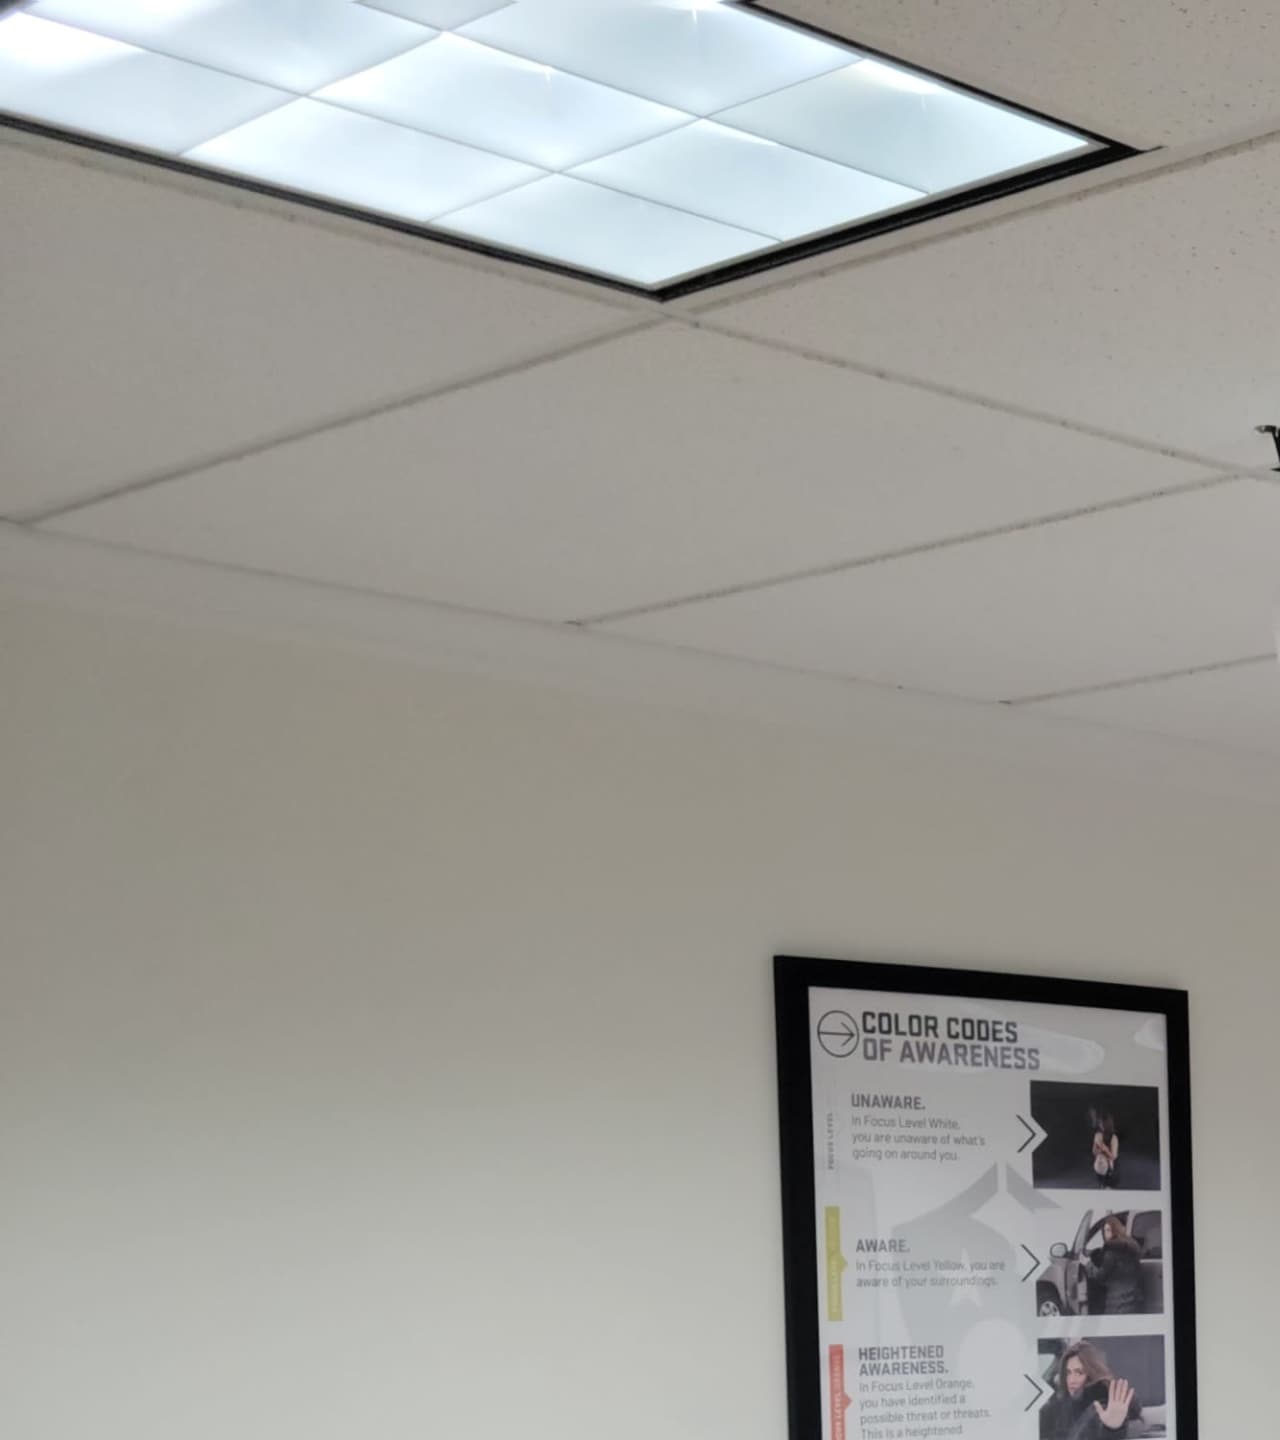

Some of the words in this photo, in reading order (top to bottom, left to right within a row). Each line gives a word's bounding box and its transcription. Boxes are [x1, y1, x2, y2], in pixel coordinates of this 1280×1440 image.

[862, 1011, 939, 1039] COLOR
[947, 1017, 1018, 1044] CODES
[863, 1038, 892, 1062] OF
[900, 1040, 1041, 1071] AWARENESS
[851, 1093, 926, 1111] UNAWARE.
[852, 1115, 861, 1126] In
[863, 1116, 896, 1128] Focus
[899, 1117, 926, 1128] Level
[852, 1131, 871, 1144] you
[874, 1132, 891, 1143] are
[893, 1132, 938, 1145] unaware
[940, 1134, 951, 1145] of
[953, 1134, 985, 1146] what's
[852, 1148, 882, 1161] going
[884, 1149, 898, 1160] on
[900, 1149, 937, 1160] around
[856, 1238, 911, 1253] AWARE.
[856, 1259, 866, 1271] In
[868, 1259, 900, 1272] Focus
[903, 1261, 930, 1271] Level
[969, 1261, 987, 1272] you
[989, 1261, 1005, 1271] are
[856, 1277, 888, 1288] aware
[892, 1276, 903, 1287] of
[904, 1277, 926, 1288] your
[858, 1345, 944, 1361] HEIGHTENED
[859, 1361, 949, 1376] AWARENESS.
[859, 1383, 869, 1393] In
[871, 1381, 904, 1392] Focus
[906, 1379, 933, 1390] Level
[860, 1399, 879, 1411] you
[881, 1397, 906, 1408] have
[908, 1395, 957, 1405] identified
[860, 1412, 904, 1426] possible
[906, 1411, 938, 1422] threat
[940, 1410, 951, 1419] or
[862, 1428, 883, 1440] This
[886, 1427, 895, 1438] is
[905, 1425, 963, 1438] heightened
